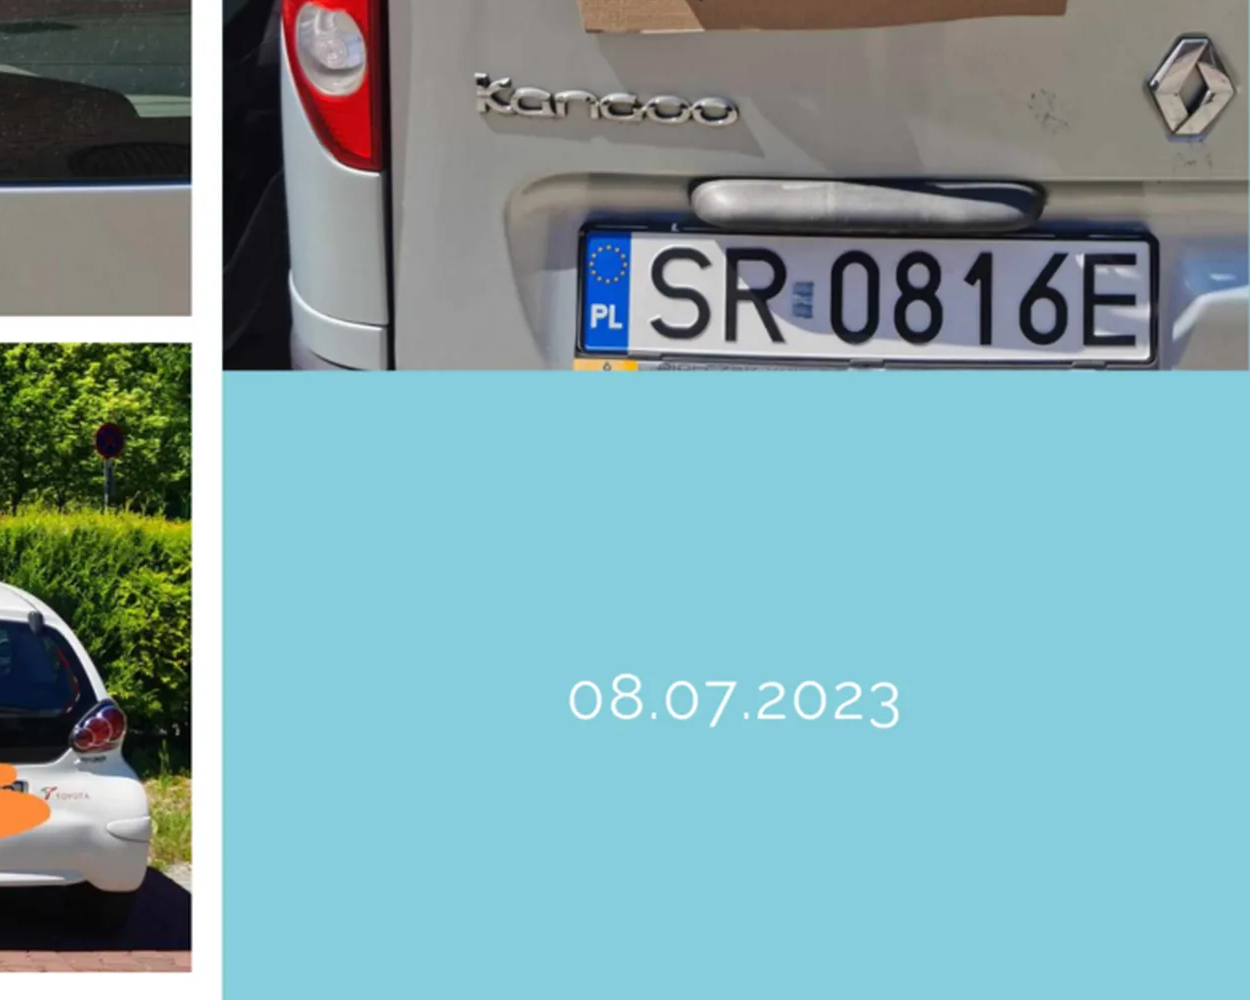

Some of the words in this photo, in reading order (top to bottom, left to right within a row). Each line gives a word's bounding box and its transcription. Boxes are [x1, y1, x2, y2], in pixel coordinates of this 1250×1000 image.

[474, 72, 739, 126] Kangoo
[590, 303, 623, 329] PL
[650, 246, 787, 344] SR
[829, 250, 1137, 347] 0816E
